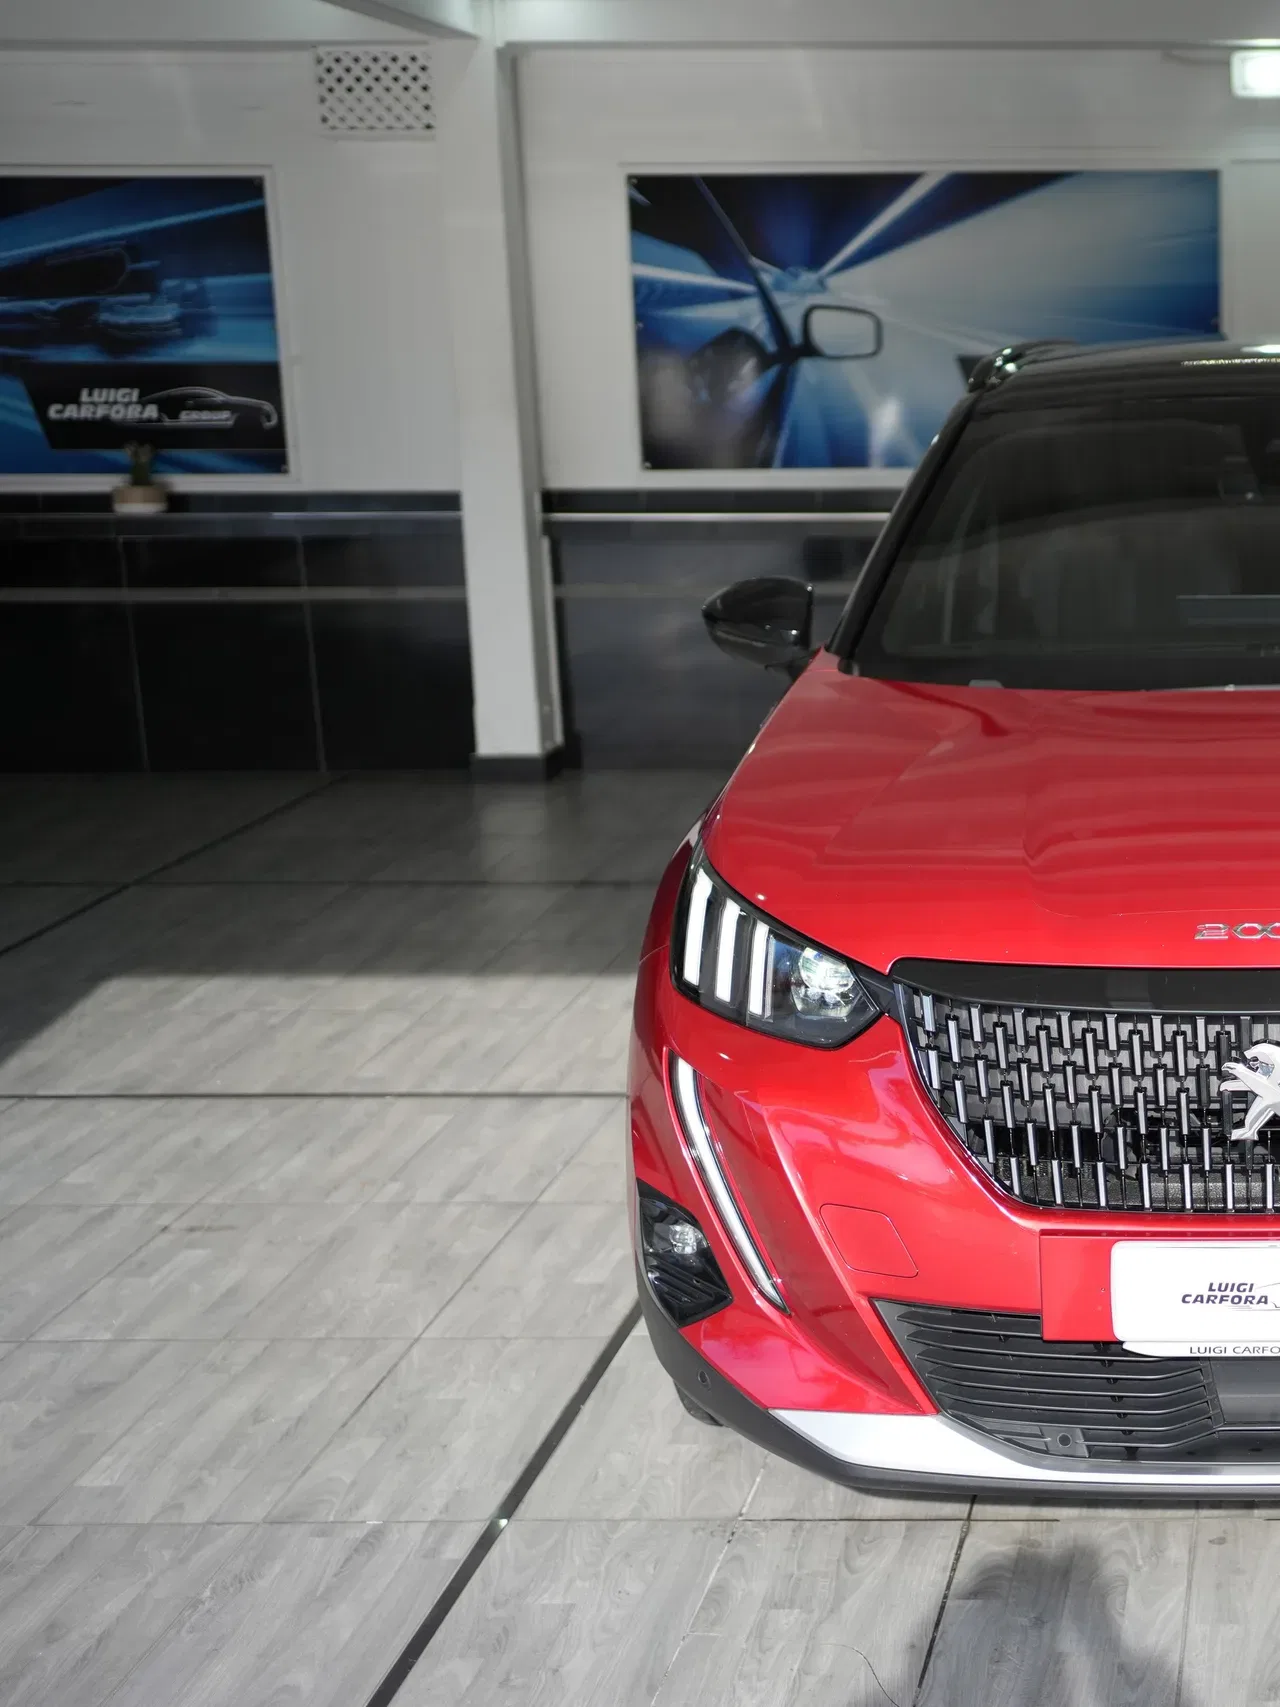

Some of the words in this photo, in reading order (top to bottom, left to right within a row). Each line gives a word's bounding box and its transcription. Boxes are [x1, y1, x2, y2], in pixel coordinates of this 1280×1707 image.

[79, 387, 140, 403] LUIGI
[47, 403, 160, 421] CARFORA
[1208, 1282, 1254, 1293] LUIGI
[1181, 1294, 1269, 1305] CARFORA
[1189, 1346, 1228, 1355] LUIGI
